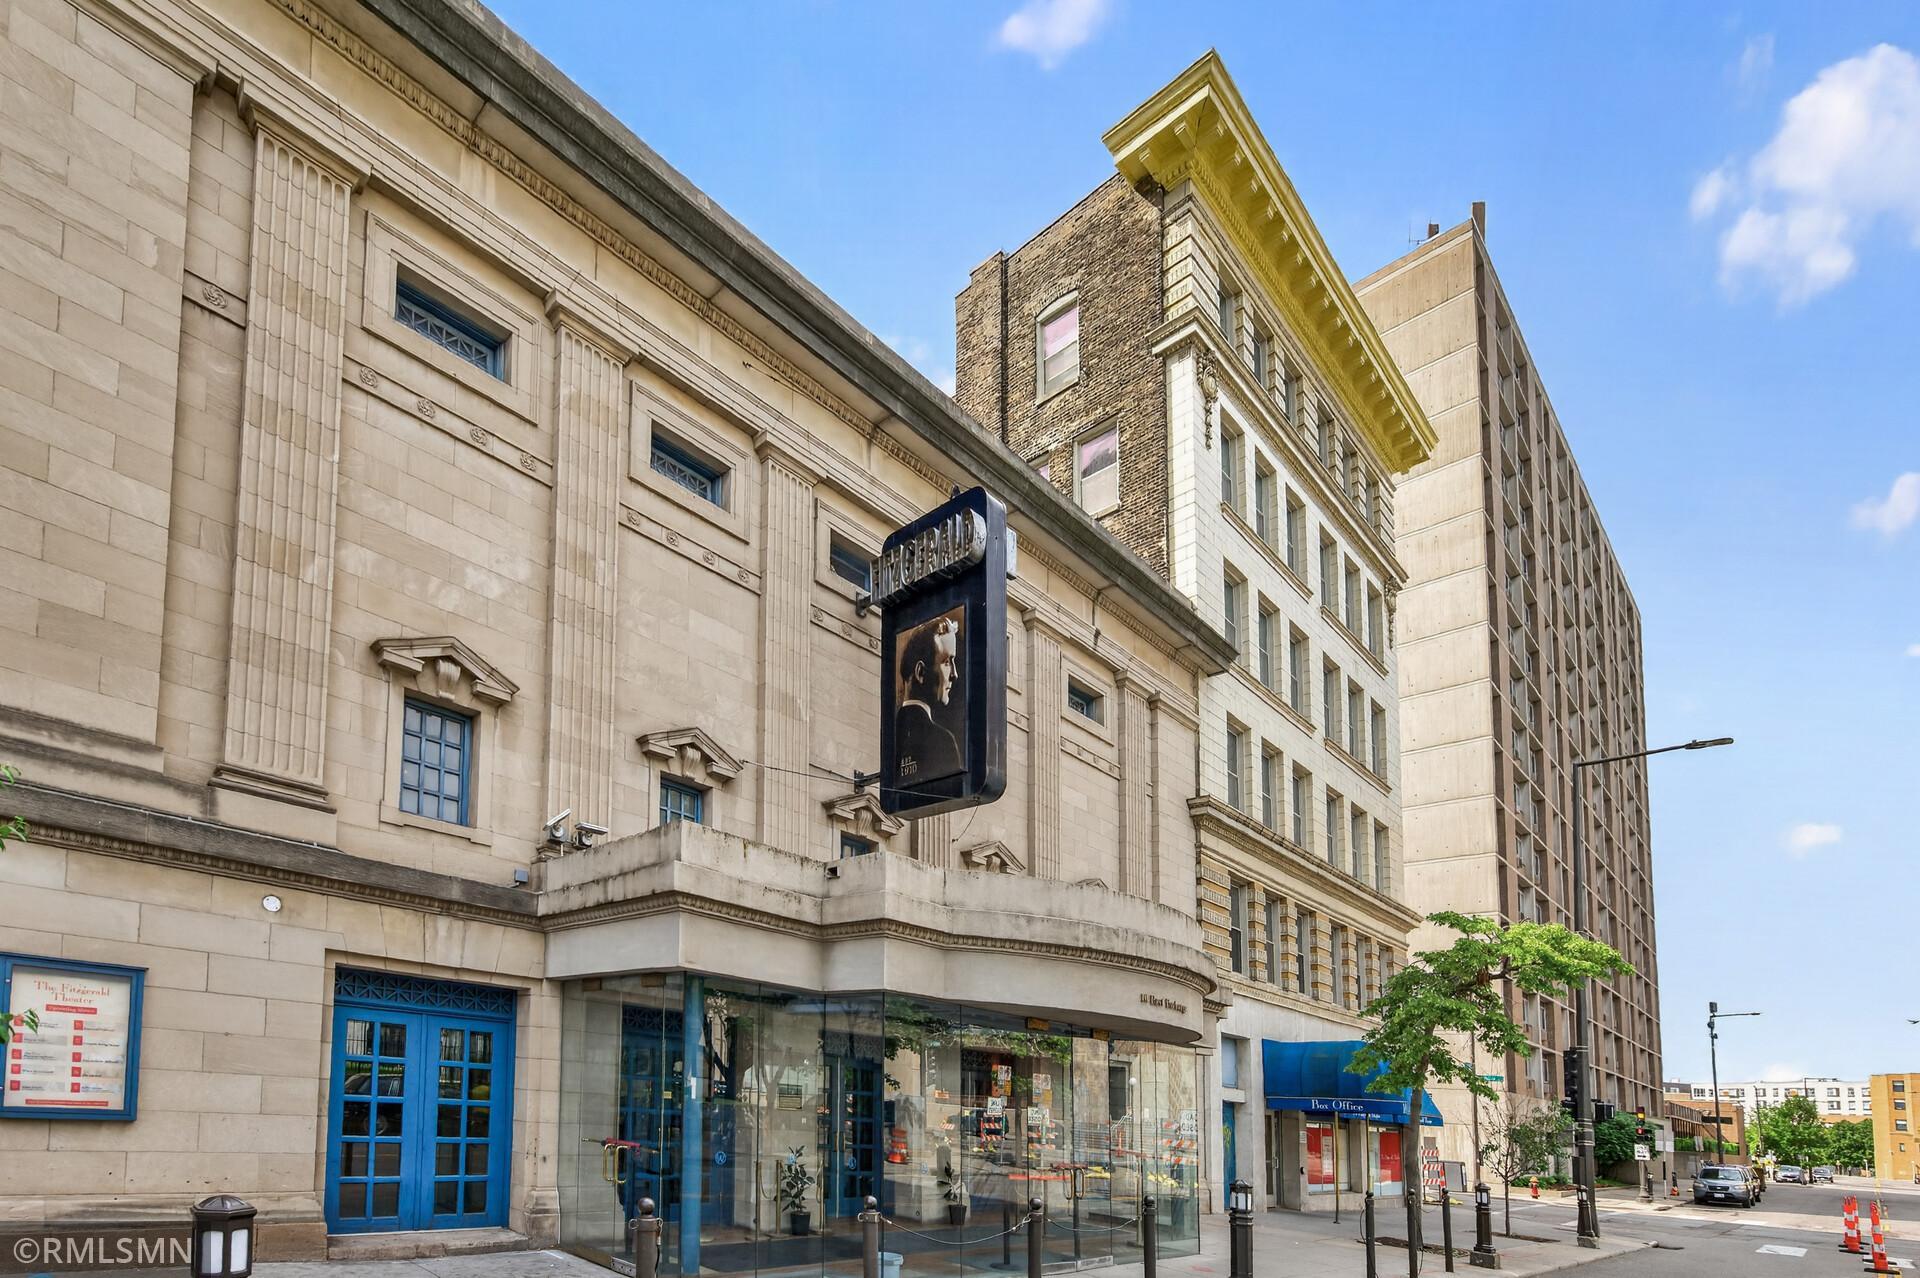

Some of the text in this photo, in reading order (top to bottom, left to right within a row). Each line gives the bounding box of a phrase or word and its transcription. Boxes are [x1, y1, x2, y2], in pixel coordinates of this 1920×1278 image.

[61, 983, 110, 997] Fitzgerald
[52, 992, 95, 1004] Theater
[1311, 1099, 1364, 1112] Box Office
